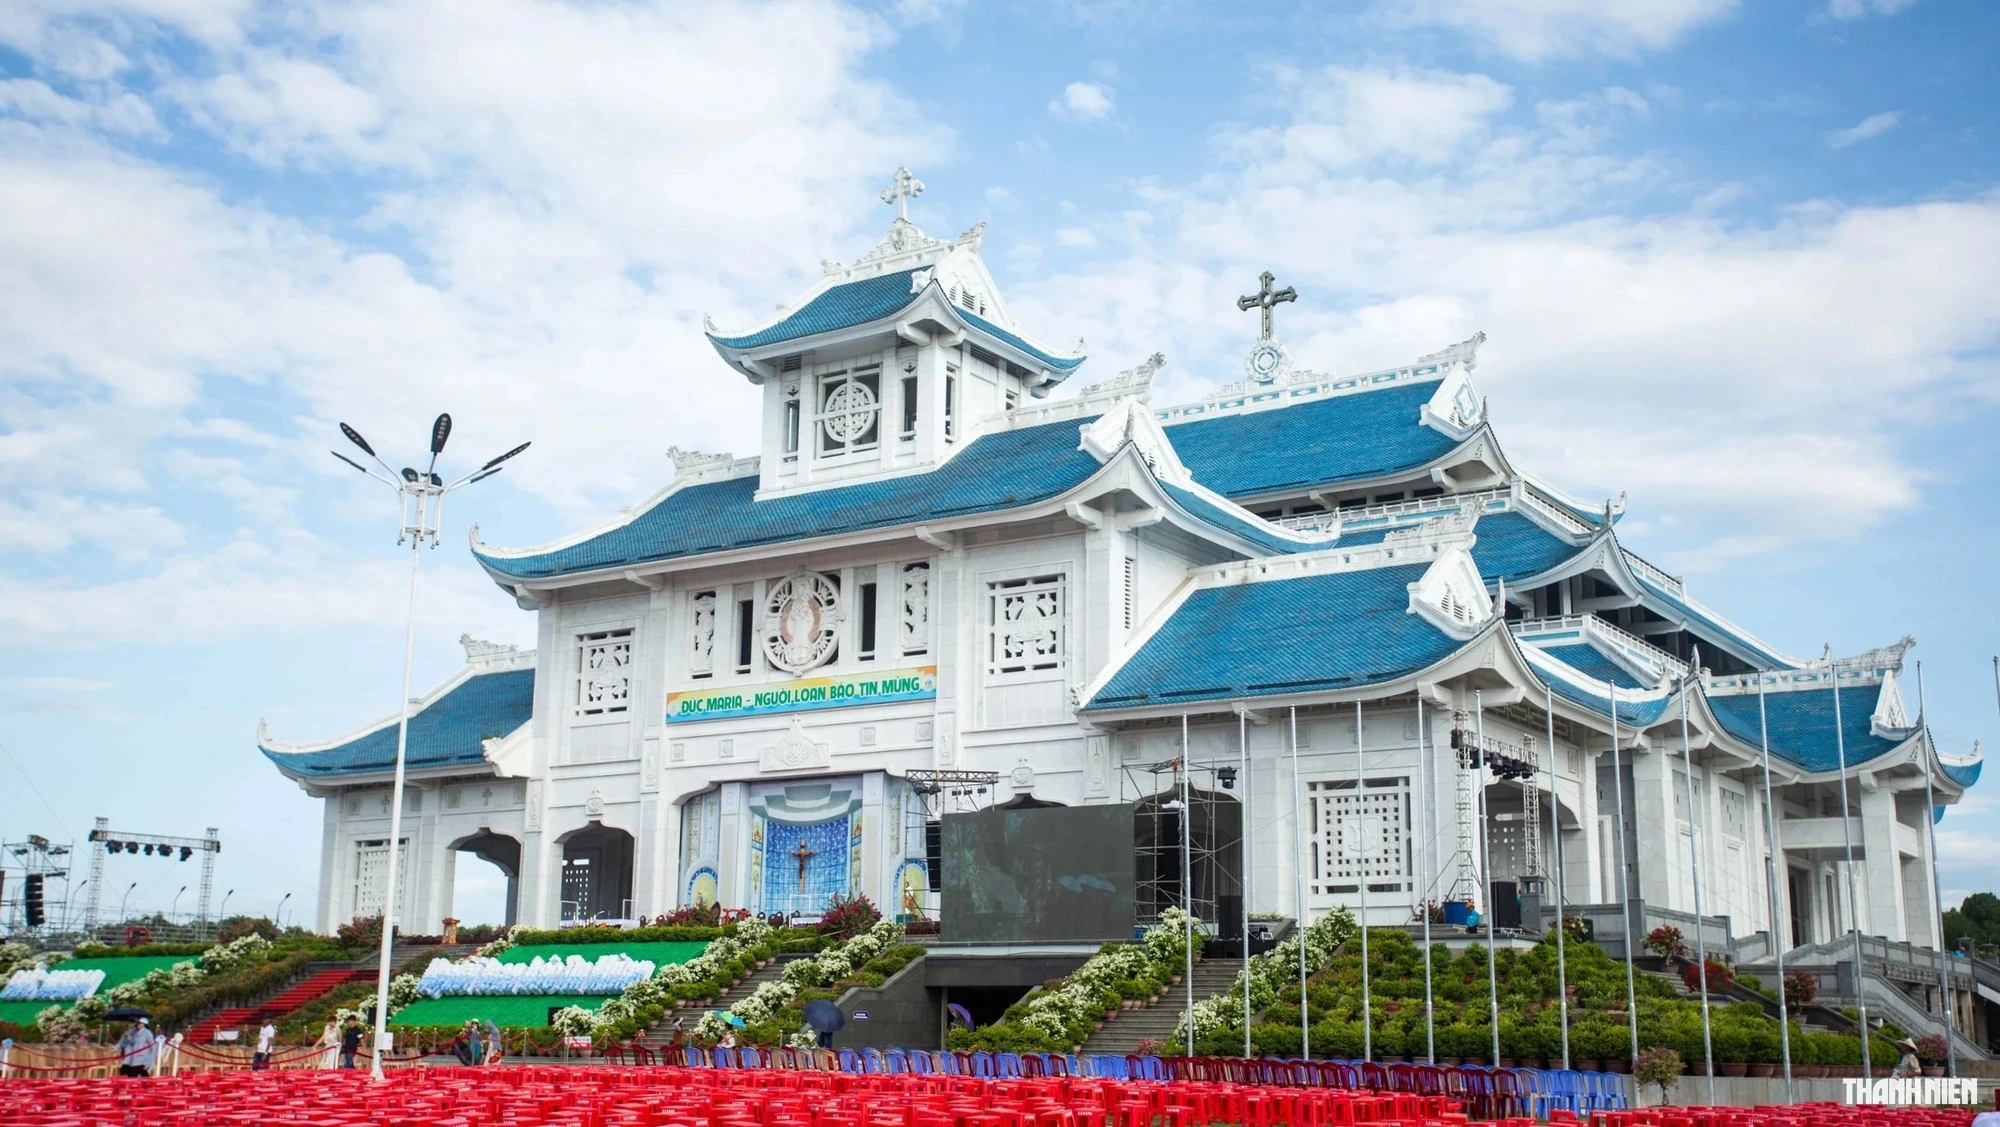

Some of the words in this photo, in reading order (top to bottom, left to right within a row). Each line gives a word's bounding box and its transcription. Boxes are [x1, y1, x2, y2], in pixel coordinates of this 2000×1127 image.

[706, 695, 743, 711] MARIA
[794, 686, 826, 702] LOAN
[829, 681, 855, 699] BÁO
[858, 681, 878, 696] TIN
